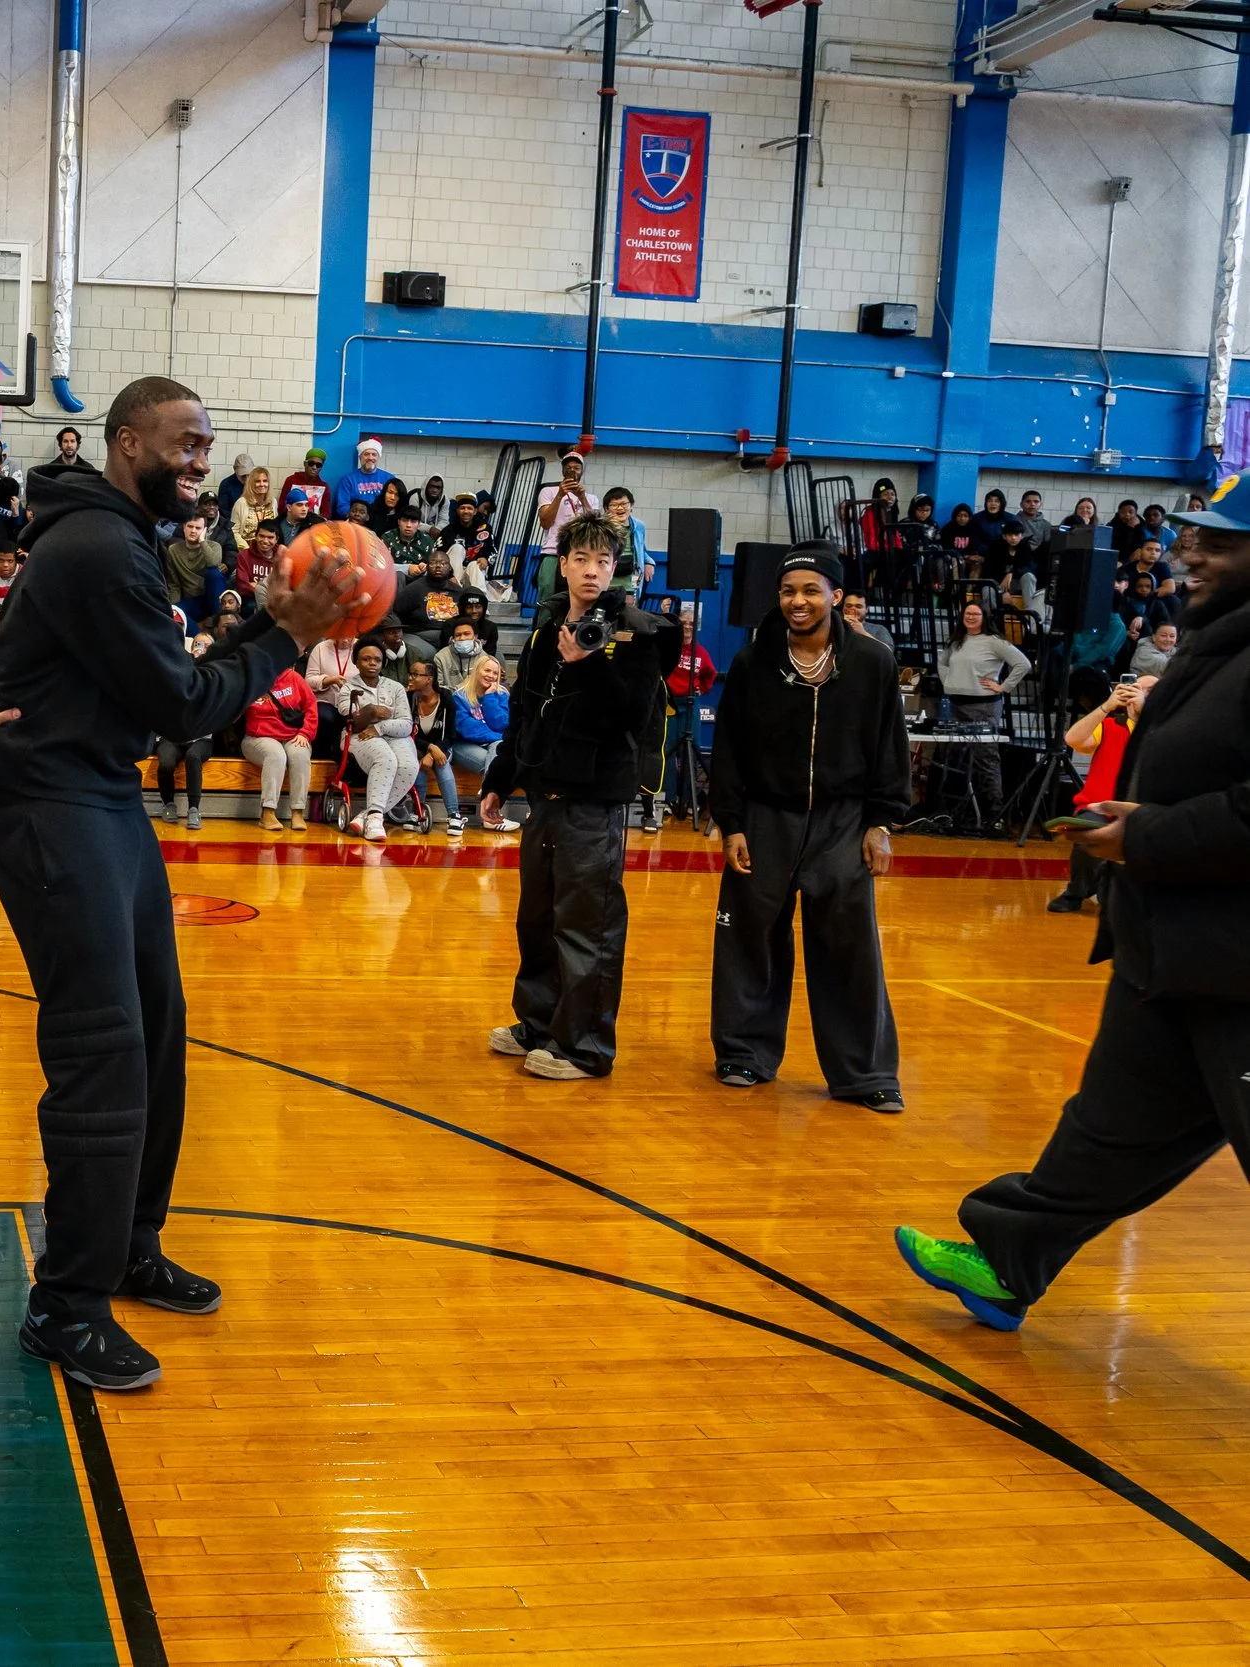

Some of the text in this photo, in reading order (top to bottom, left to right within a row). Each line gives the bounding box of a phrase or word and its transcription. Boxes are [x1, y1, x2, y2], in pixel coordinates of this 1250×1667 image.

[639, 227, 681, 238] HOME OF
[625, 238, 692, 251] CHARLESTOWN
[634, 252, 682, 263] ATHLETICS
